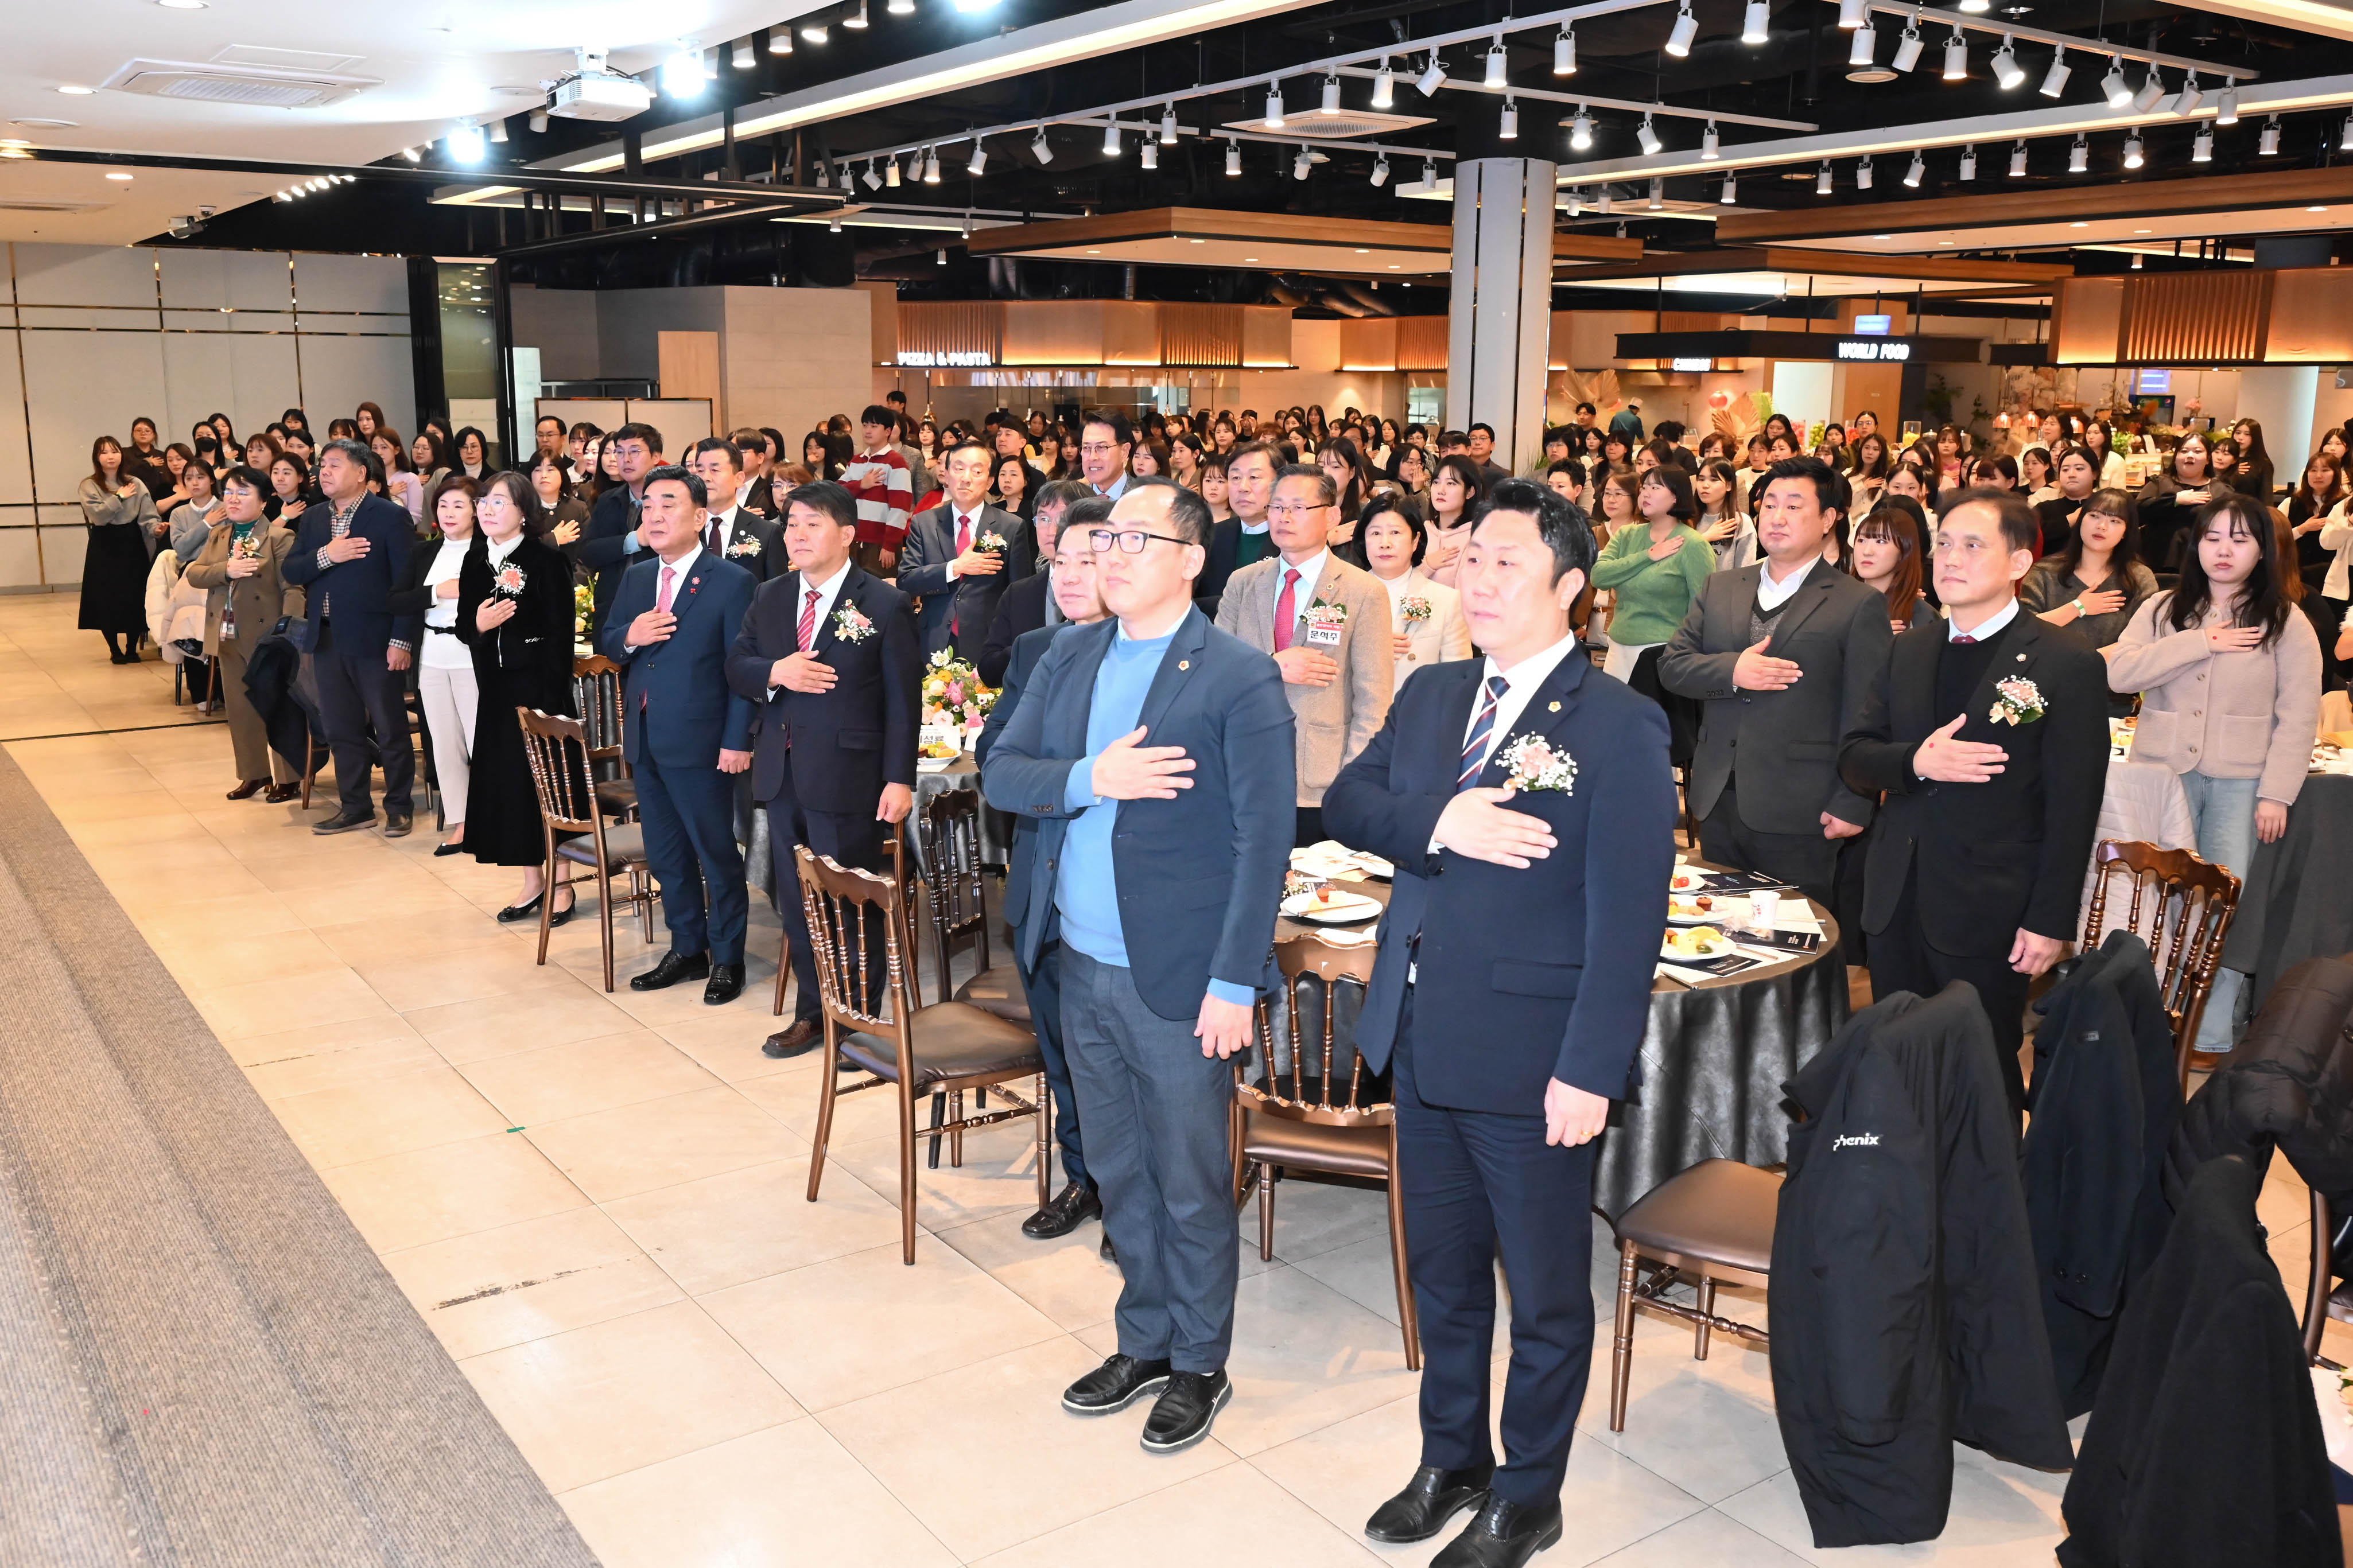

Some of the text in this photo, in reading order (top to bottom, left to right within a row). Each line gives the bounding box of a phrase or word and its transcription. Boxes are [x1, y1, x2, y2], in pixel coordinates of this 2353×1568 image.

[1839, 343, 1909, 360] WORLD FOOD
[898, 352, 991, 366] PIZZA & PASTA
[1310, 630, 1338, 641] 문석주
